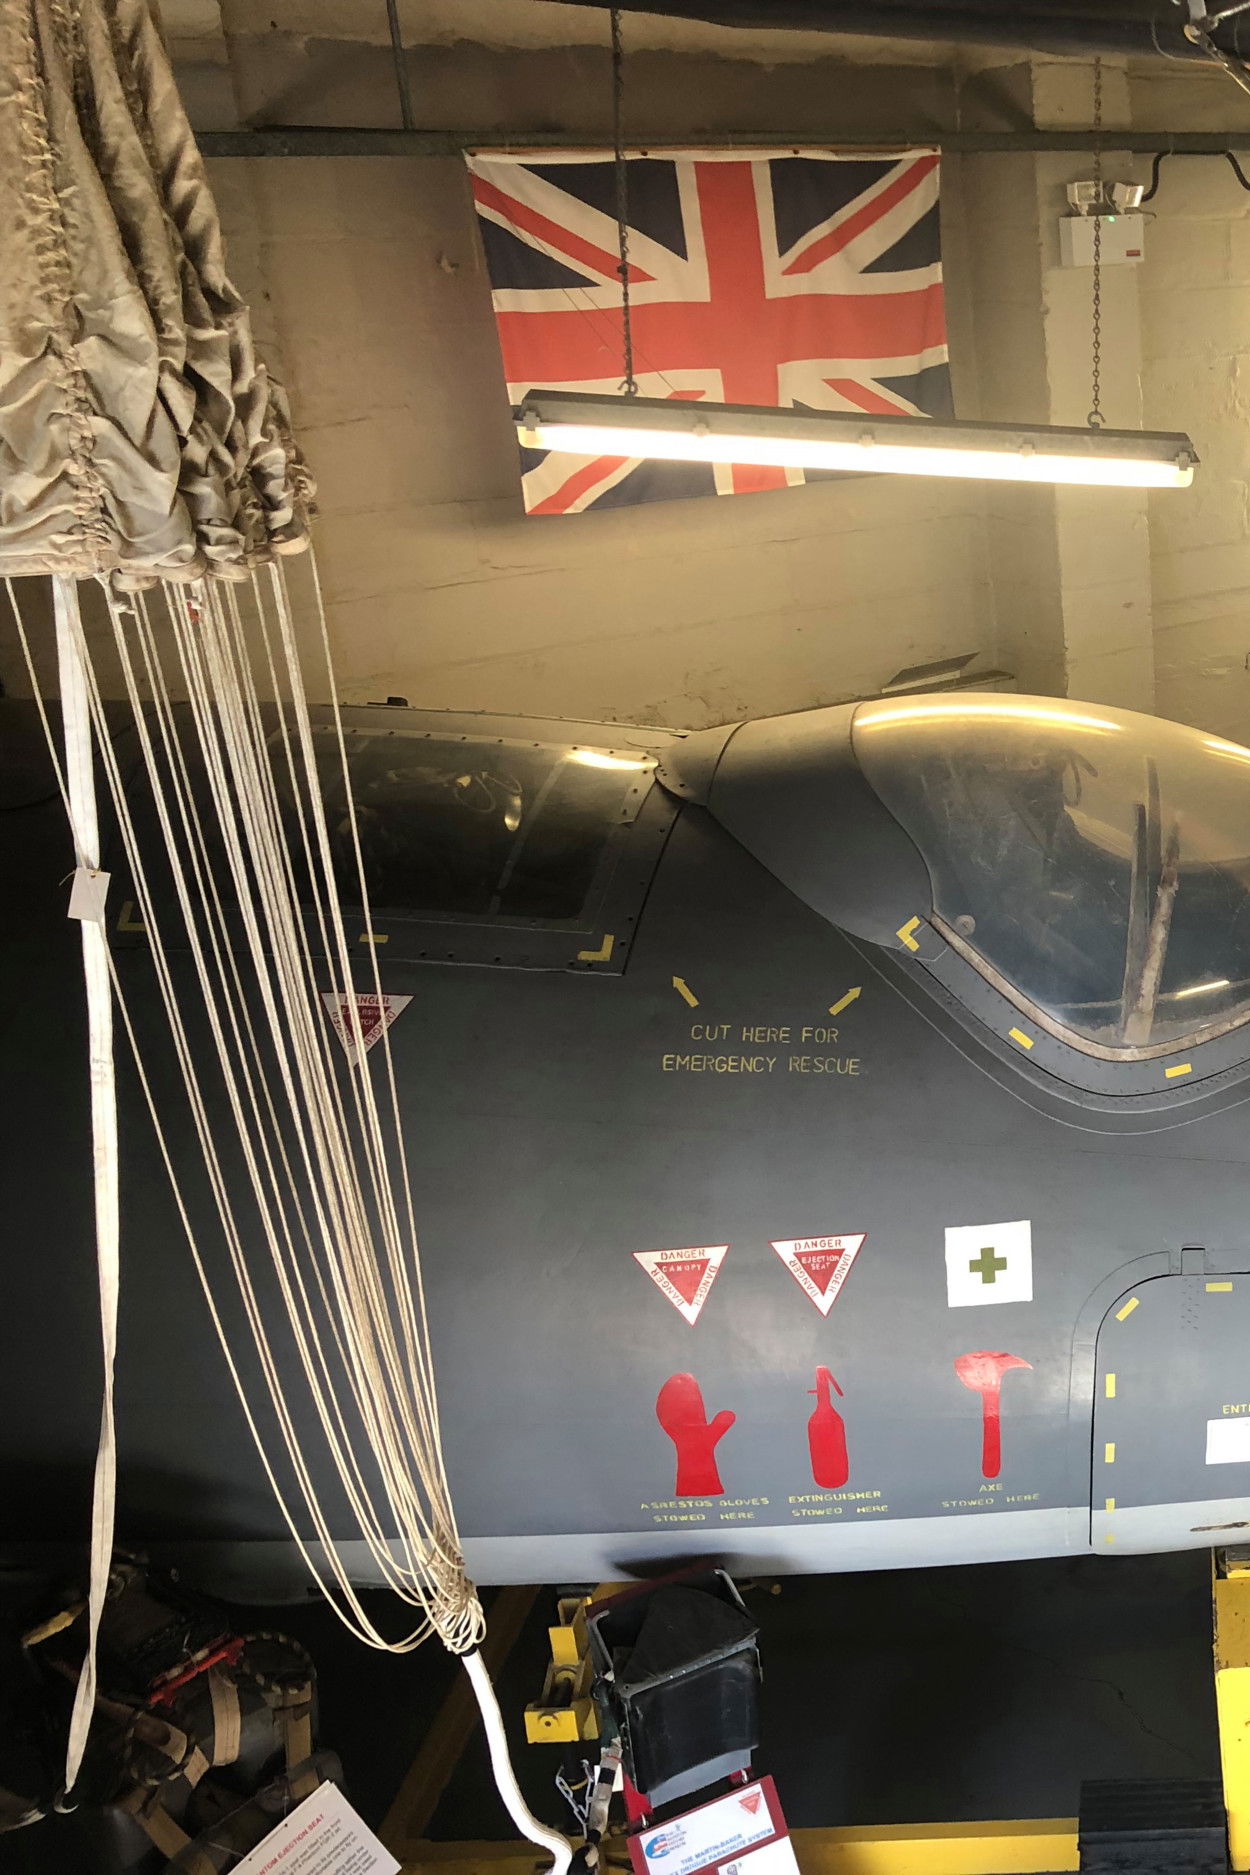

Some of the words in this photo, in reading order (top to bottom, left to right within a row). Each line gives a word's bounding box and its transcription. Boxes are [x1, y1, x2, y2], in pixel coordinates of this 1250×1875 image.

[691, 1025, 732, 1041] CUT
[742, 1026, 791, 1043] HERE
[802, 1027, 839, 1044] FOR
[662, 1054, 777, 1073] EMERGENCY
[789, 1056, 861, 1075] RESCUE
[794, 1239, 842, 1251] DANGER
[661, 1249, 706, 1260] DANGER
[801, 1255, 841, 1264] EJECTION
[811, 1262, 831, 1271] SEAT
[789, 1259, 820, 1297] DANGER
[828, 1253, 852, 1293] DANGER
[650, 1268, 685, 1306] DANGER
[979, 1483, 1004, 1493] AXE
[720, 1497, 770, 1507] GLOVES
[788, 1490, 881, 1504] EXTINGUISHER
[941, 1497, 995, 1508] STOWED
[1006, 1493, 1041, 1503] HERE
[653, 1513, 706, 1523] STOWED
[720, 1511, 756, 1520] HERE
[792, 1507, 843, 1517] STOWED
[856, 1505, 889, 1513] HERE
